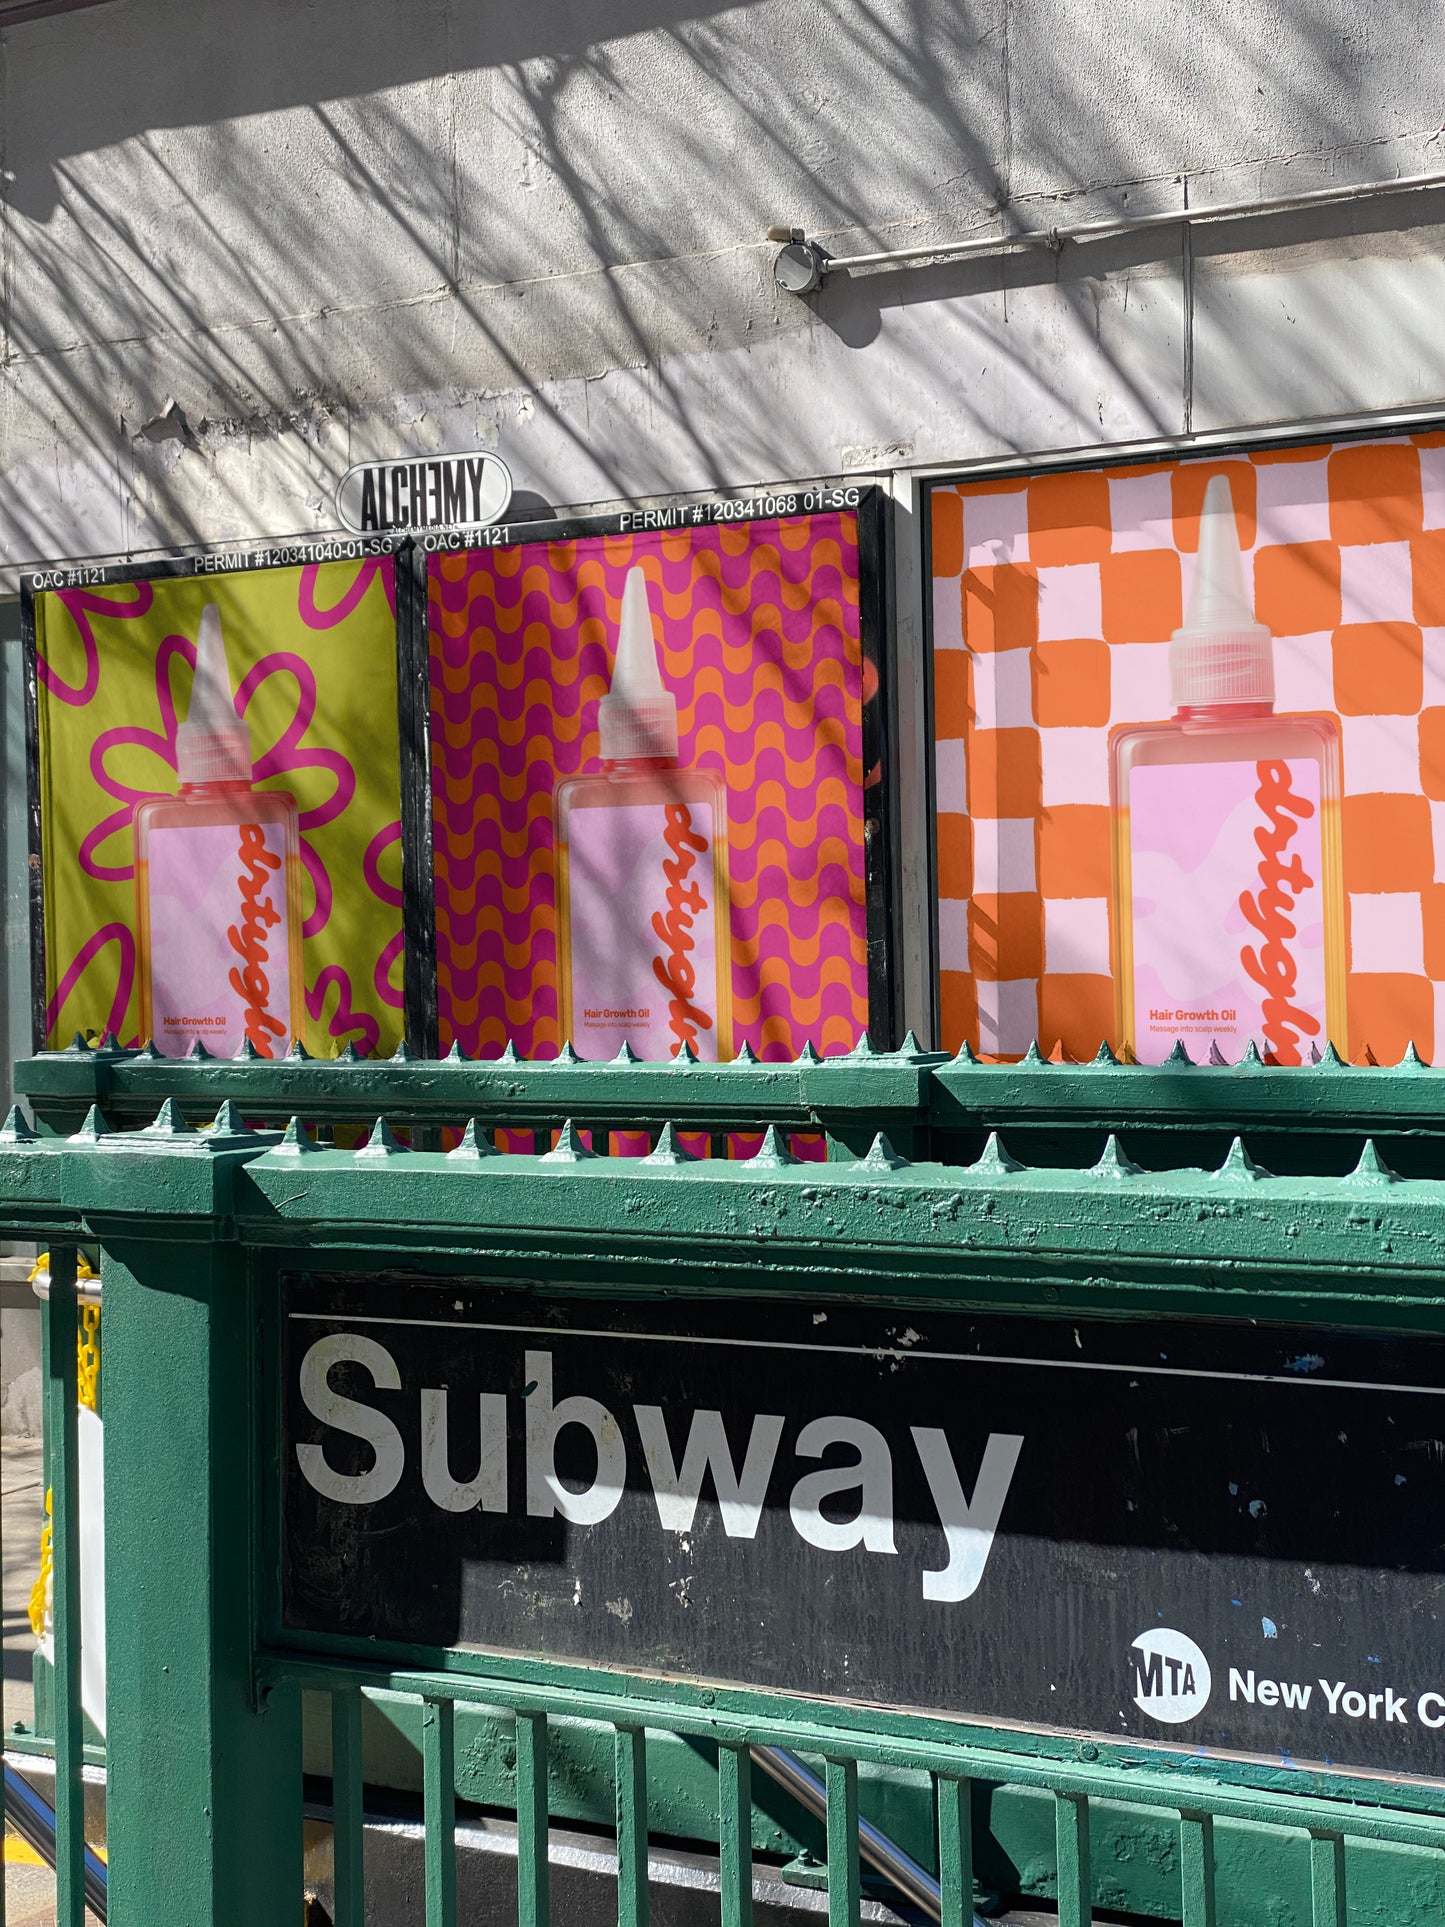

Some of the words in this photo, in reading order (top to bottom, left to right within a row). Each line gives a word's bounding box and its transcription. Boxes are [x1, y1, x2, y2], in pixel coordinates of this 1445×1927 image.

[361, 458, 485, 531] ALCHEMY
[619, 507, 688, 531] PERMIT
[692, 495, 797, 522] #120341068
[424, 532, 460, 551] OAC
[464, 527, 510, 547] #1121
[194, 553, 251, 572] PERMIT
[255, 538, 393, 567] #120341040-01-SG
[32, 571, 64, 589] OAC
[67, 568, 106, 586] #1121
[163, 1016, 181, 1026] Hair
[182, 1016, 214, 1026] Growth
[215, 1016, 227, 1026] Oil
[584, 1008, 602, 1018] Hair
[603, 1008, 636, 1018] Growth
[638, 1008, 650, 1018] Oil
[1149, 1009, 1174, 1021] Hair
[1175, 1009, 1219, 1021] Growth
[1221, 1009, 1237, 1021] Oil
[1149, 1025, 1179, 1034] Massage
[1180, 1025, 1193, 1033] into
[1194, 1024, 1213, 1034] scalp
[1213, 1025, 1237, 1034] weekly
[295, 1333, 1024, 1603] Subway
[1133, 1648, 1197, 1698] MTA
[1229, 1667, 1312, 1710] New
[1318, 1678, 1408, 1724] York
